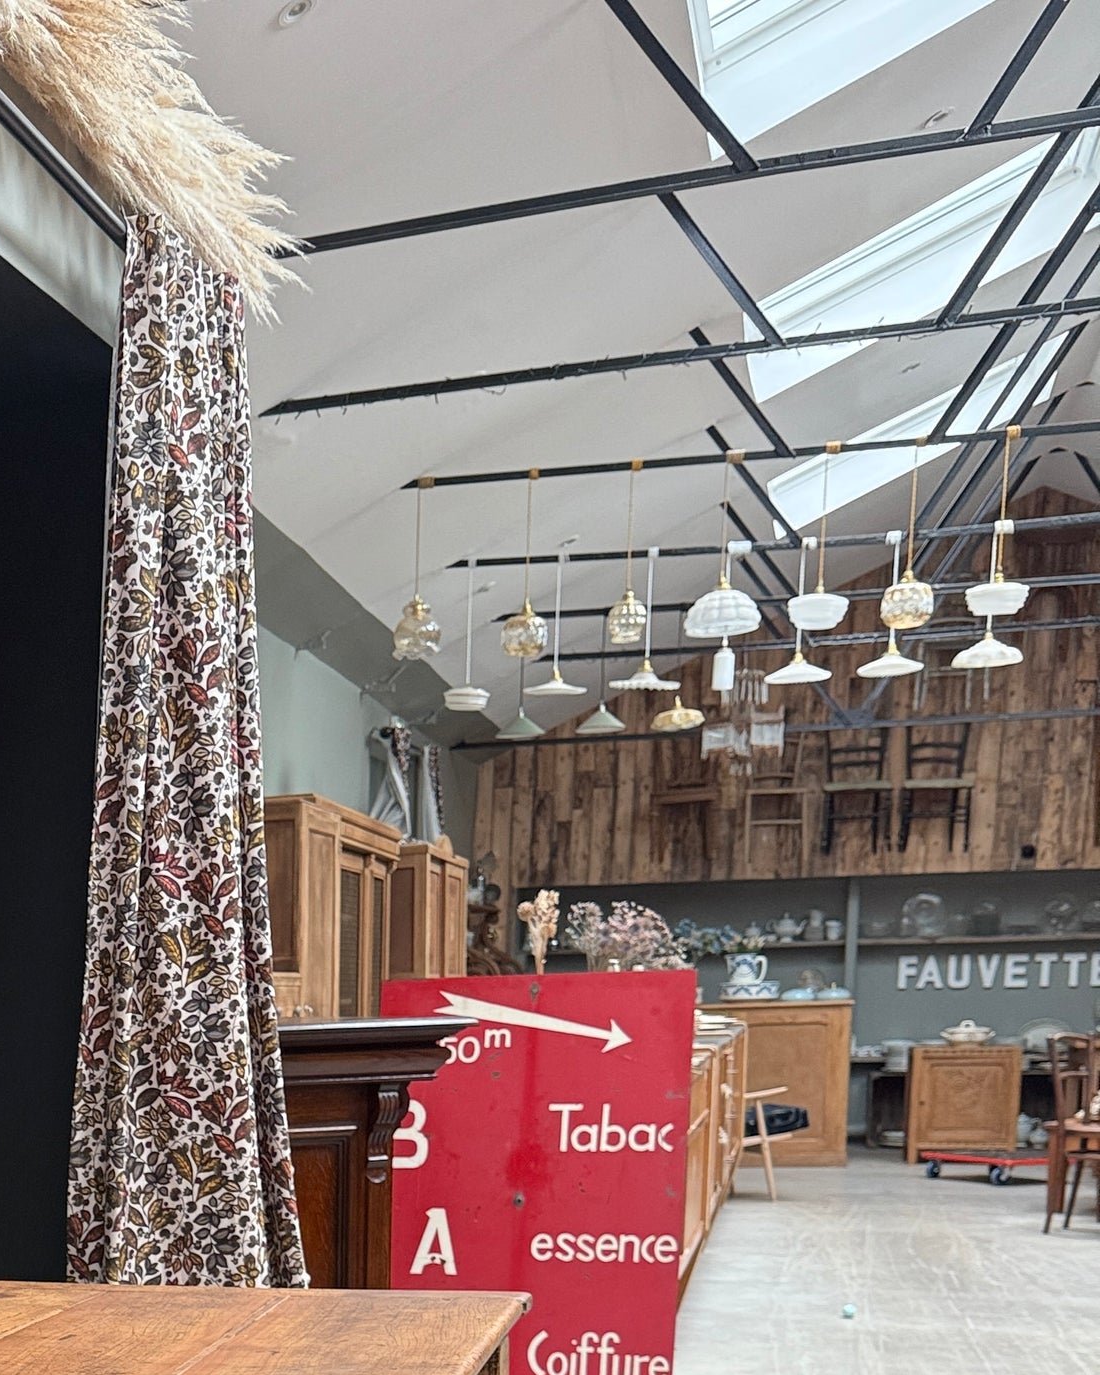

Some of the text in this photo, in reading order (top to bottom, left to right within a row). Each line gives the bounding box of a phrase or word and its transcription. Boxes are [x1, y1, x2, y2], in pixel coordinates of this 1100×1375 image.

[548, 1103, 674, 1152] Tabac
[409, 1207, 458, 1276] A
[530, 1232, 678, 1263] essence
